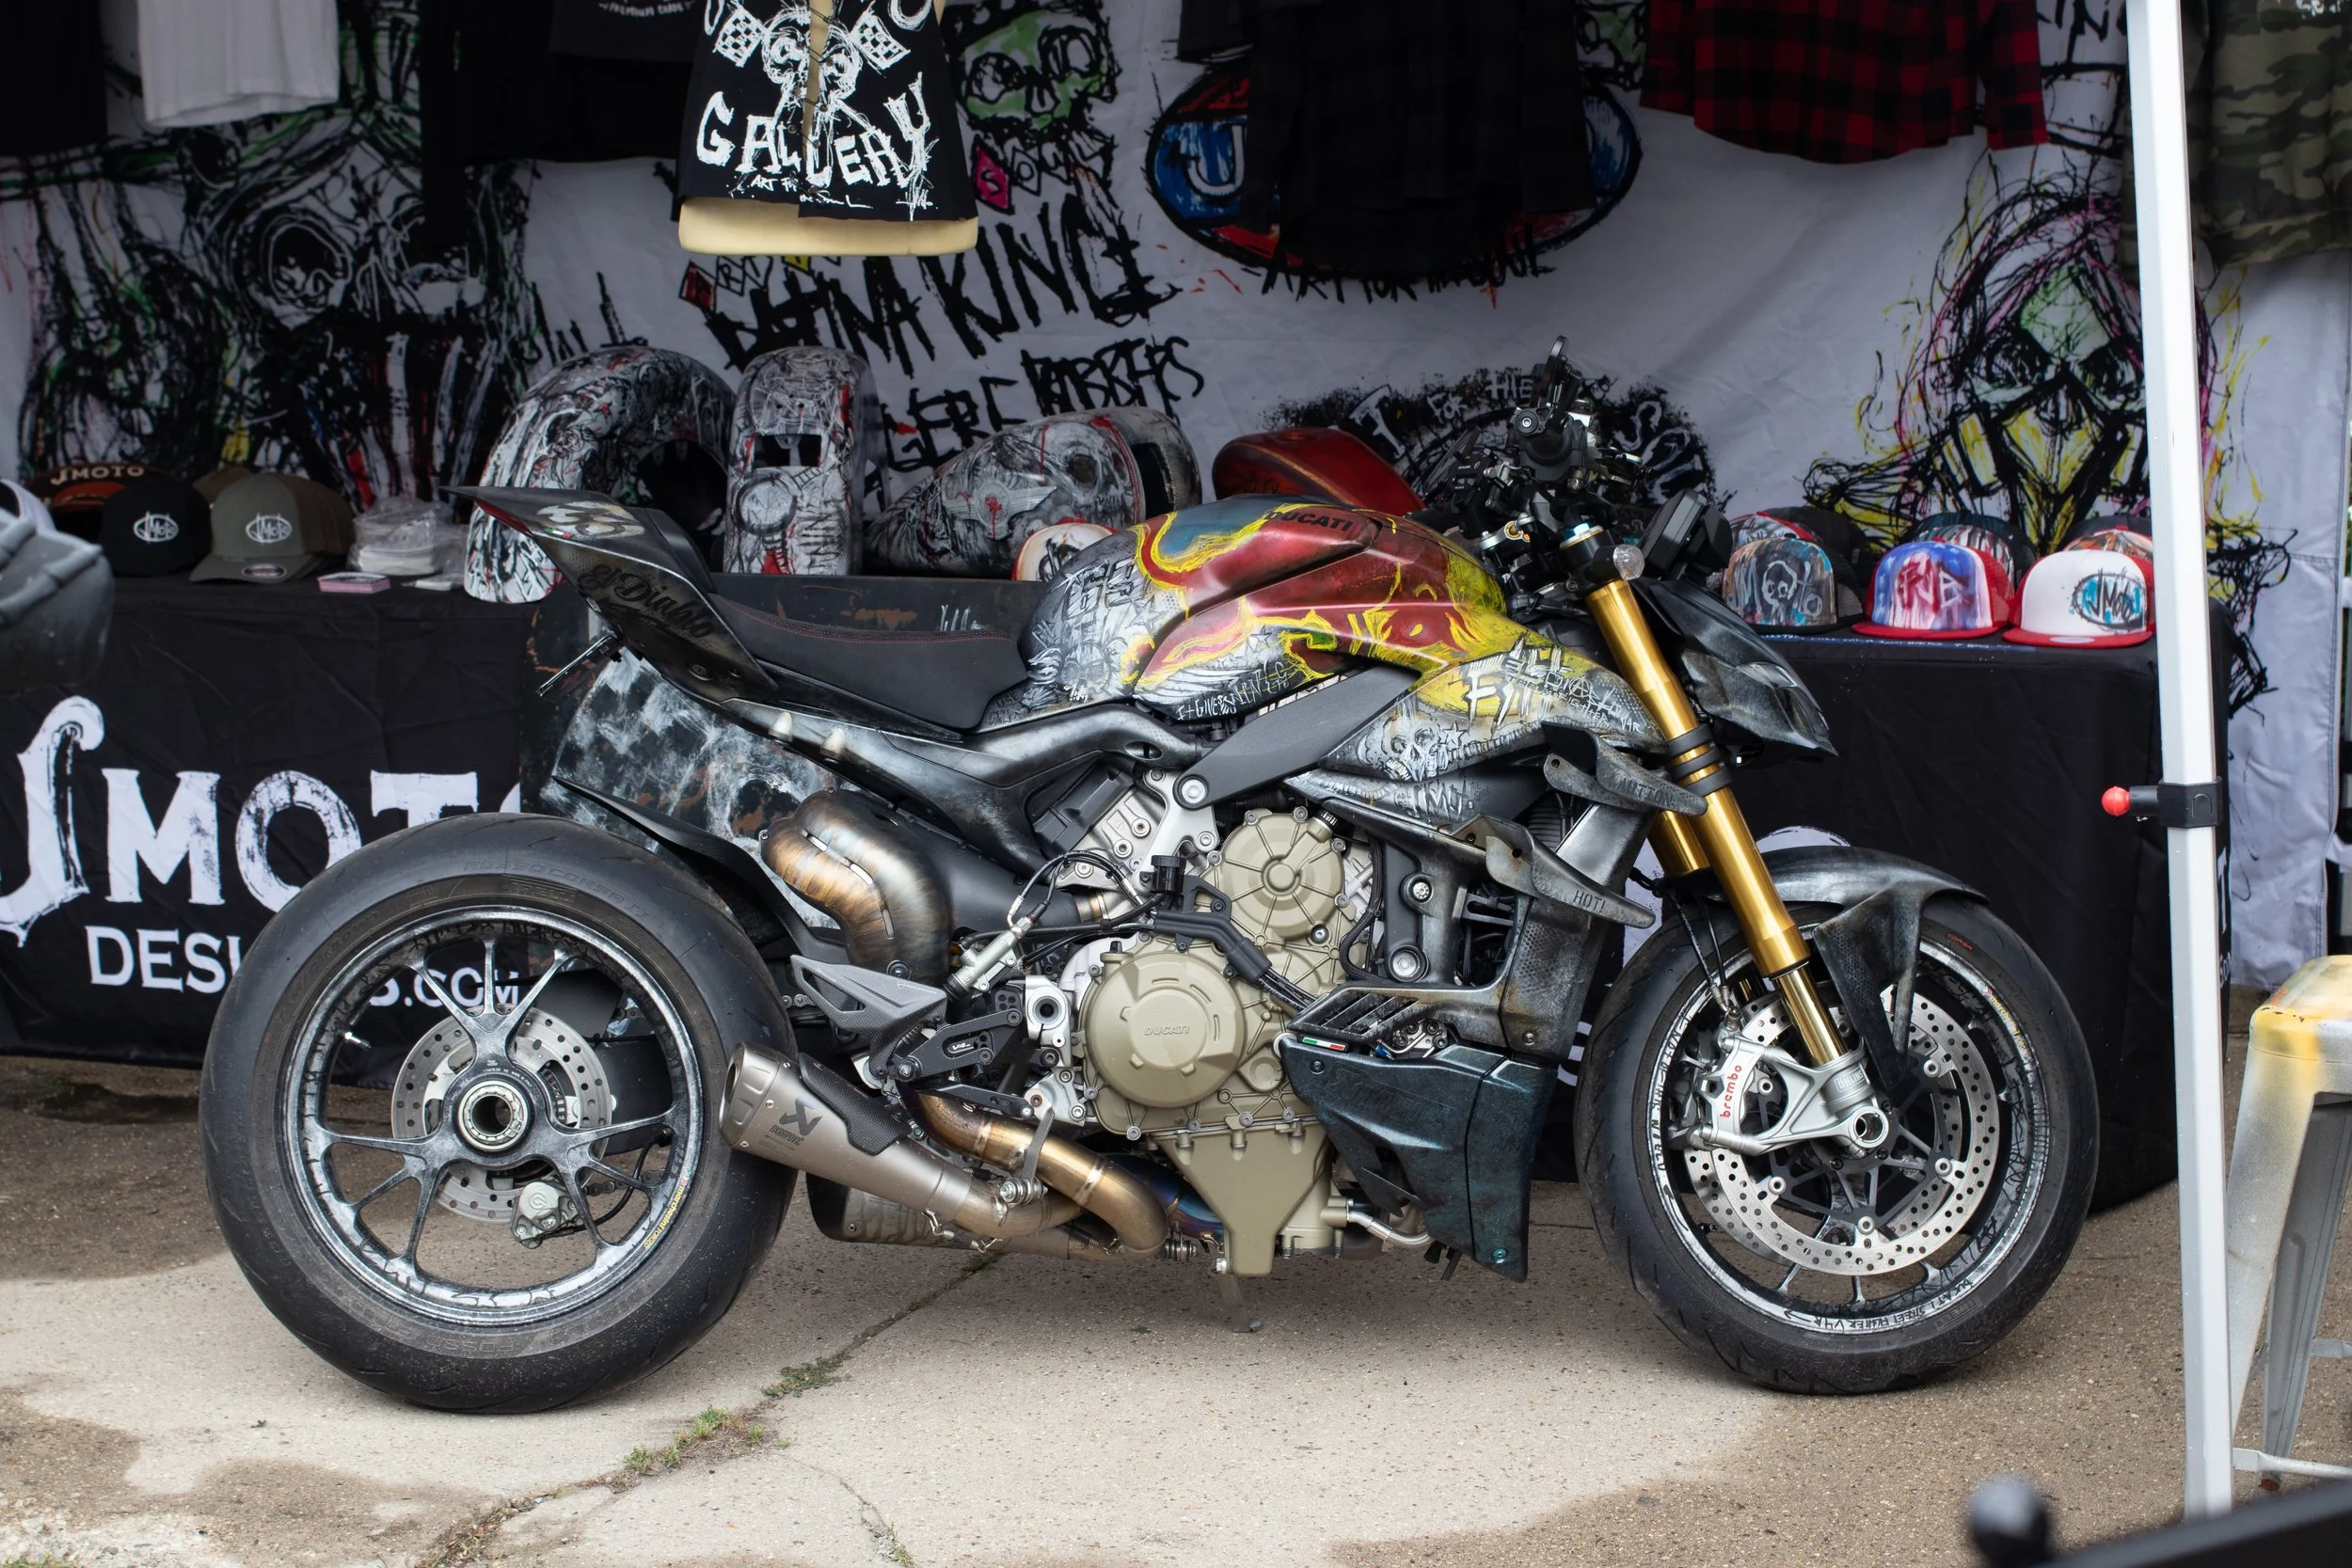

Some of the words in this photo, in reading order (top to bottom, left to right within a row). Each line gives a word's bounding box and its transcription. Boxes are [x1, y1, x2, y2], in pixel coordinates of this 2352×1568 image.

[50, 466, 145, 485] JMOTO
[1268, 511, 1355, 531] DUCATI
[613, 572, 716, 639] Diablo
[0, 696, 520, 947] JMOT
[1572, 889, 1606, 913] HOT!
[1143, 1025, 1190, 1036] DUCATI
[1719, 1064, 1743, 1119] brembo
[661, 1185, 685, 1229] marchesini
